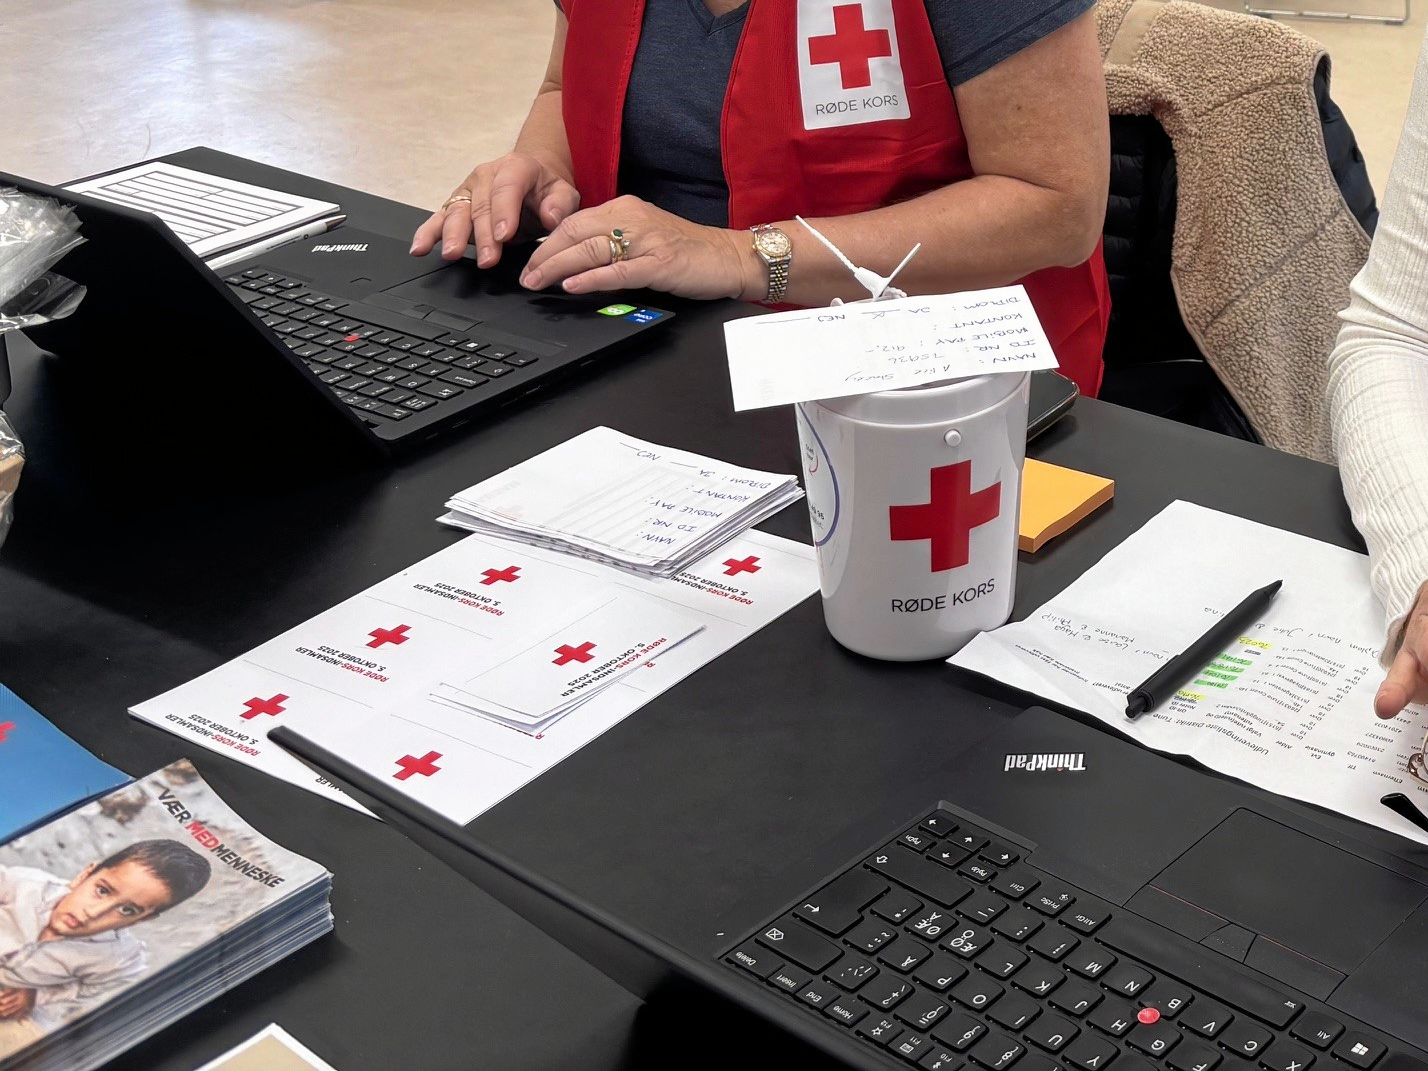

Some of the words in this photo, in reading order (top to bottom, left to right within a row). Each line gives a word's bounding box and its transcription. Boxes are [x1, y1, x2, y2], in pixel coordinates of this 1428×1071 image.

[815, 100, 858, 115] RØDE
[862, 94, 899, 108] KORS
[311, 244, 369, 253] ThinkPad
[680, 572, 701, 580] 2025
[434, 583, 456, 591] 2025
[670, 576, 730, 598] KORS-INDSAML
[700, 579, 739, 593] OKTOBER
[413, 584, 482, 608] KORS-INDSAMLER
[454, 589, 492, 604] OKTOBER
[729, 595, 754, 605] RØDE
[891, 595, 947, 613] RØDE
[953, 578, 995, 606] KORS
[480, 605, 505, 617] RØDE
[317, 645, 340, 656] 2025
[640, 637, 667, 655] RØDE
[295, 647, 366, 674] KORS-INDSAMLER
[338, 652, 378, 669] OKTOBER
[591, 648, 636, 674] OKTOBER
[363, 670, 390, 682] RØDE
[560, 653, 641, 697] KORS-INDSAMLER
[567, 673, 592, 686] 2025
[188, 714, 212, 726] 2025
[165, 714, 237, 747] KORS-INDSAMLER
[209, 723, 250, 741] OKTOBER
[1205, 723, 1269, 756] Udleveringsliste
[234, 743, 261, 757] RØDE
[1004, 753, 1086, 772] ThinkPad
[158, 788, 192, 824] VÆR
[736, 951, 757, 966] Delete
[1085, 962, 1102, 973] M
[776, 974, 797, 988] Insert
[1035, 981, 1050, 992] K
[1125, 981, 1140, 992] N
[806, 991, 822, 1003] End
[833, 1005, 854, 1019] Home
[1111, 1019, 1127, 1031] H
[1048, 1034, 1063, 1046] U
